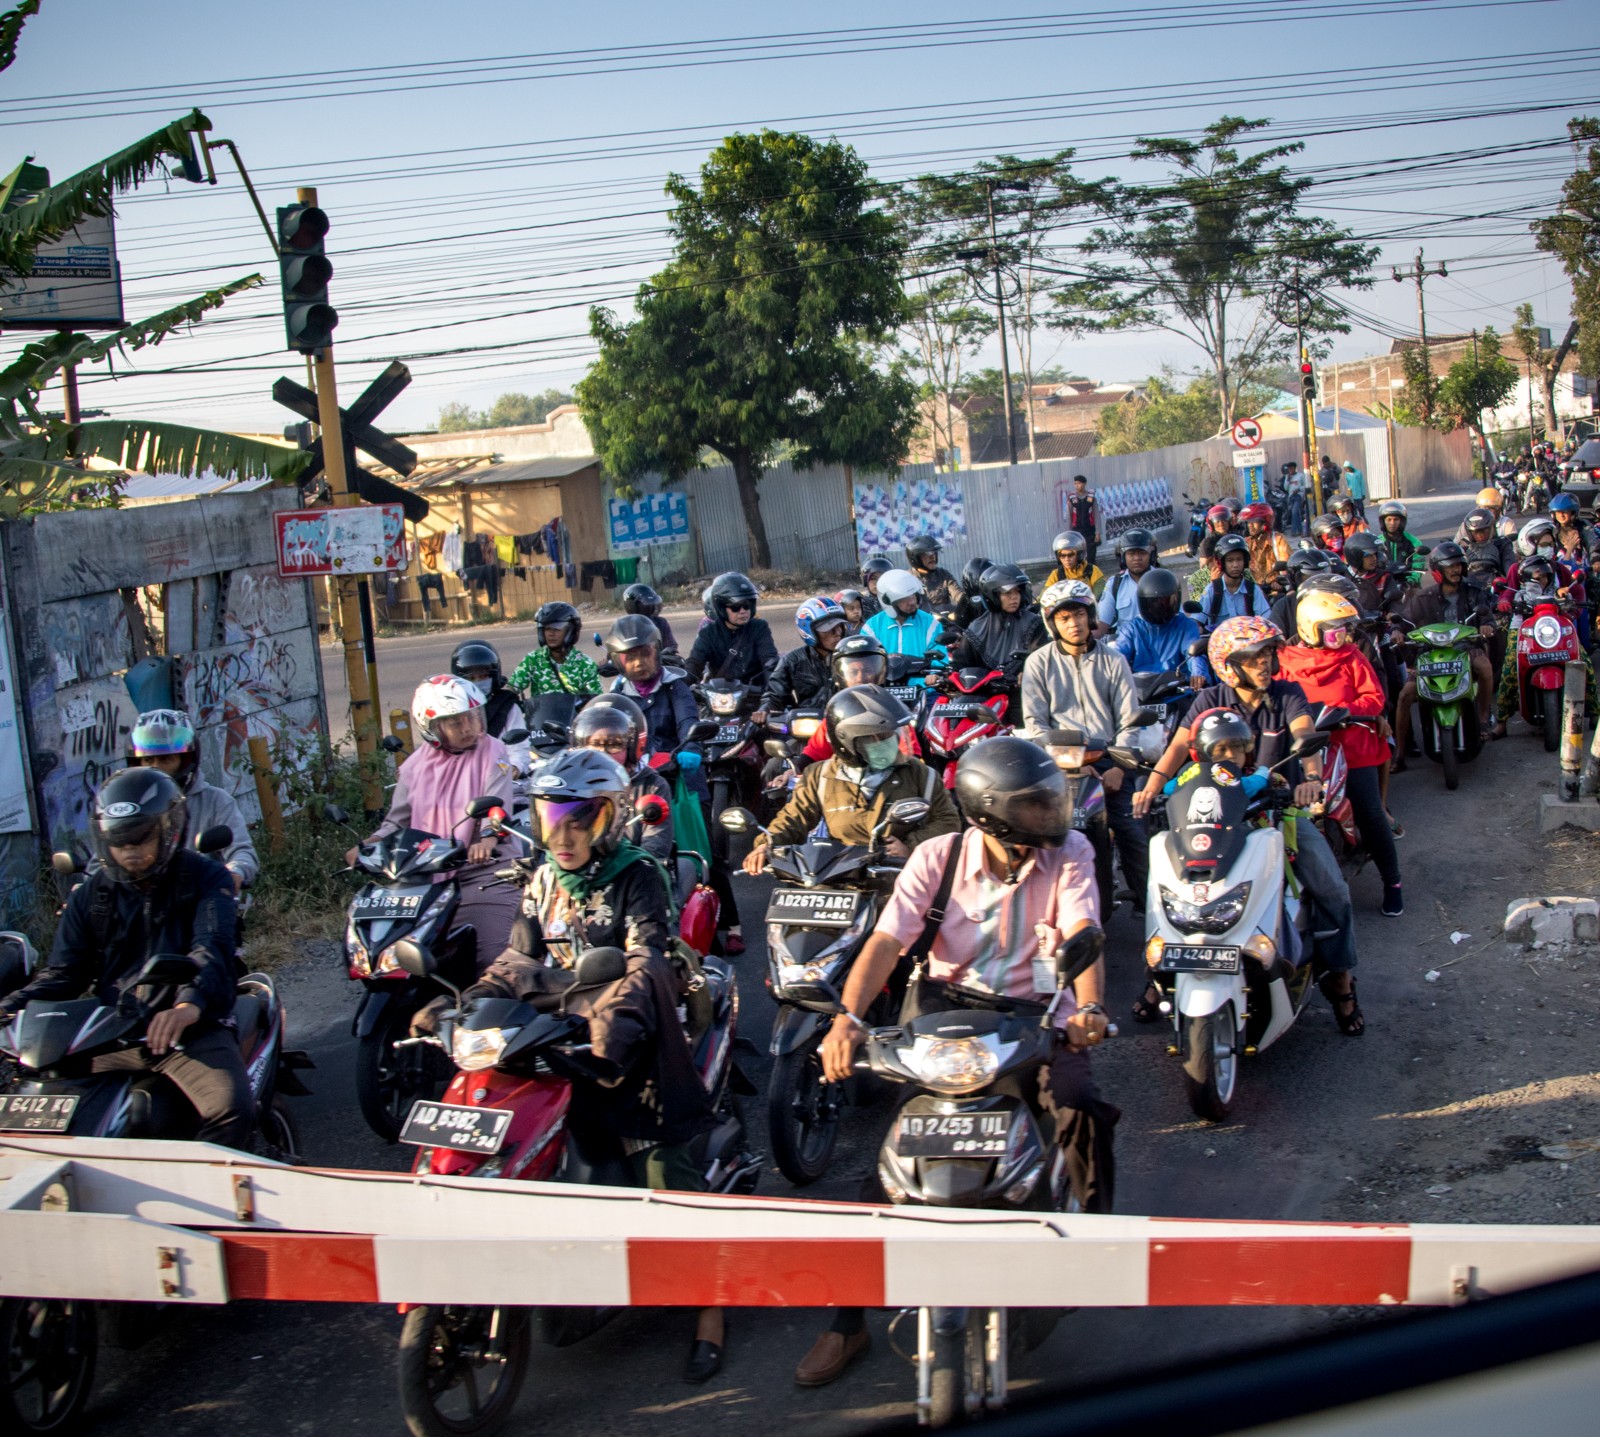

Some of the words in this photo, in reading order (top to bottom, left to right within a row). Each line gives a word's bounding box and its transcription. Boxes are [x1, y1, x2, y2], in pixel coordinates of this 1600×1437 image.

[70, 258, 109, 266] Pendidikan
[84, 269, 109, 277] Printer
[371, 896, 400, 908] 5189
[1164, 947, 1182, 960] AD
[1182, 948, 1214, 961] 4240
[1214, 949, 1237, 962] AKC
[9, 1097, 49, 1112] 6412
[412, 1106, 439, 1125] AD
[901, 1117, 923, 1137] AD
[924, 1117, 975, 1136] 2455
[980, 1116, 1008, 1136] UL
